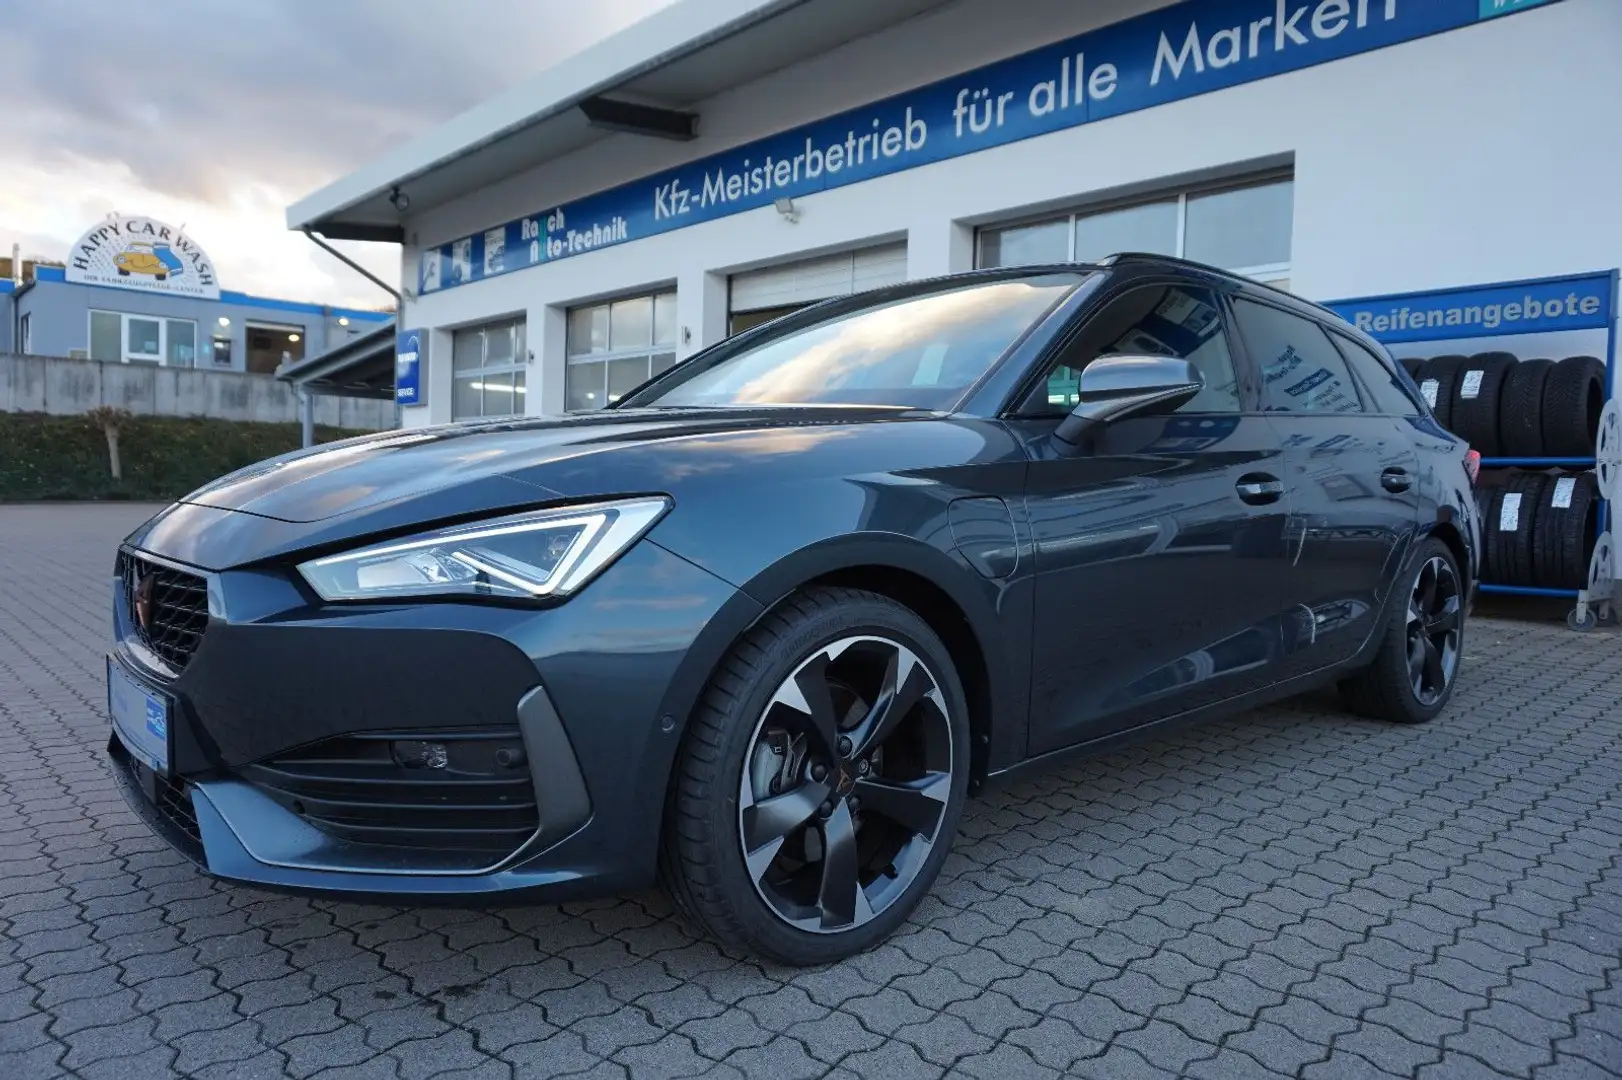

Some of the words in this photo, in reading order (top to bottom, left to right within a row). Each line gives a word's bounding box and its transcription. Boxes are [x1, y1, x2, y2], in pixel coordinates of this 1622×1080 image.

[654, 106, 927, 221] Kfz-Meisterbetrieb
[953, 86, 1014, 138] für
[1028, 53, 1118, 118] alle
[73, 222, 121, 270] HAPPY
[126, 220, 172, 240] CAR
[175, 234, 214, 286] WASH
[1354, 291, 1600, 331] Reifenangebote
